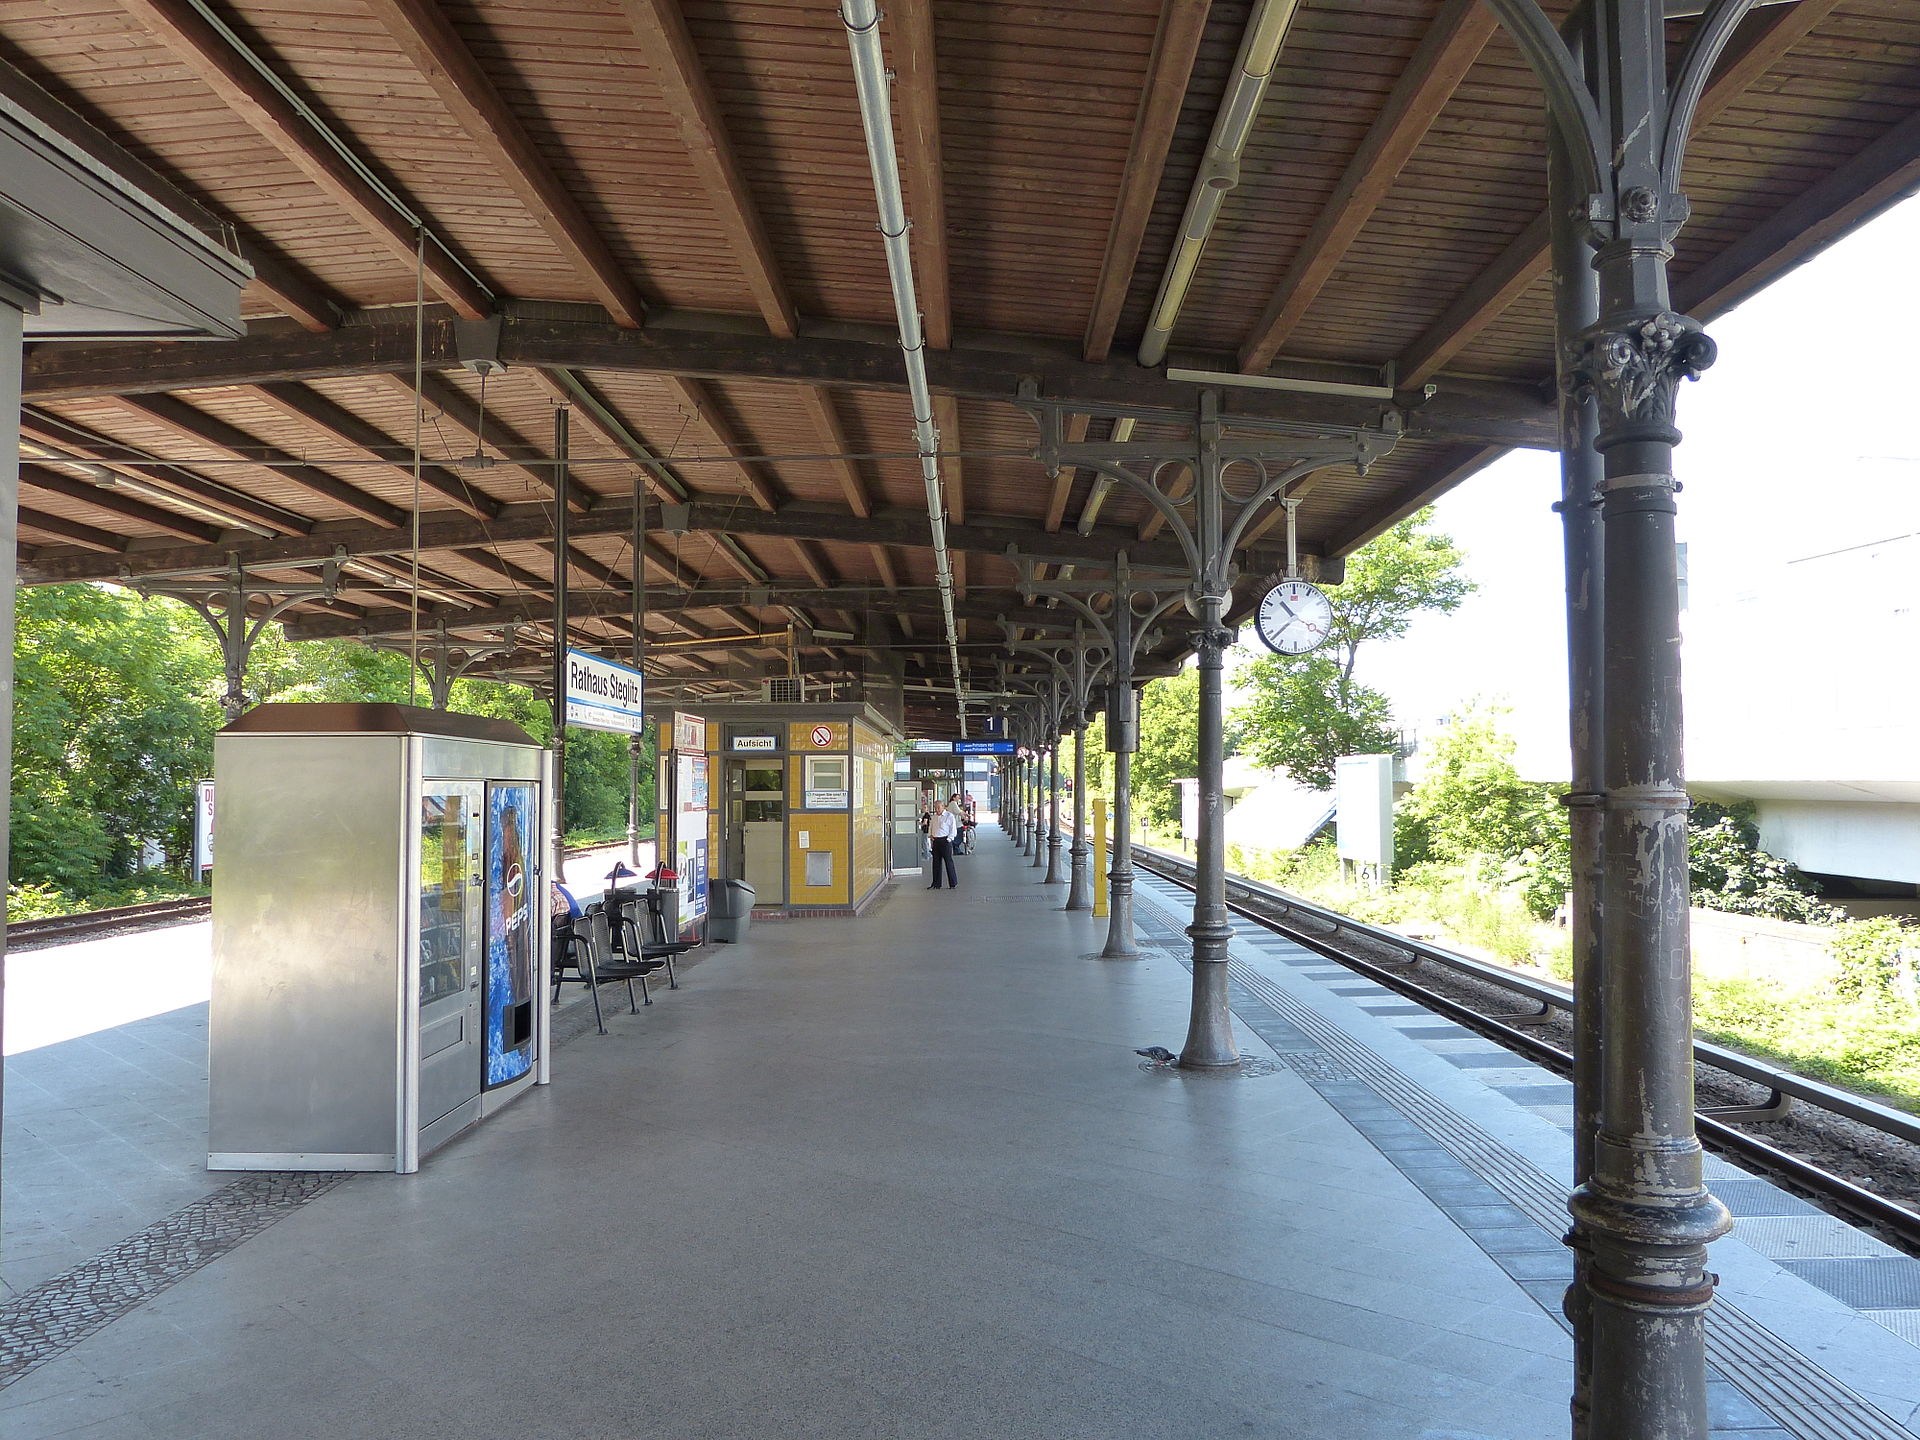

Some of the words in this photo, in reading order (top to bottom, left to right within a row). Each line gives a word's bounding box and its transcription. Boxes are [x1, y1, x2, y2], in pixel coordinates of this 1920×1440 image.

[571, 661, 608, 697] Rathaus
[610, 673, 638, 708] Steglitz
[986, 716, 993, 730] 1
[737, 739, 772, 748] Aufsicht
[1361, 867, 1370, 880] 6
